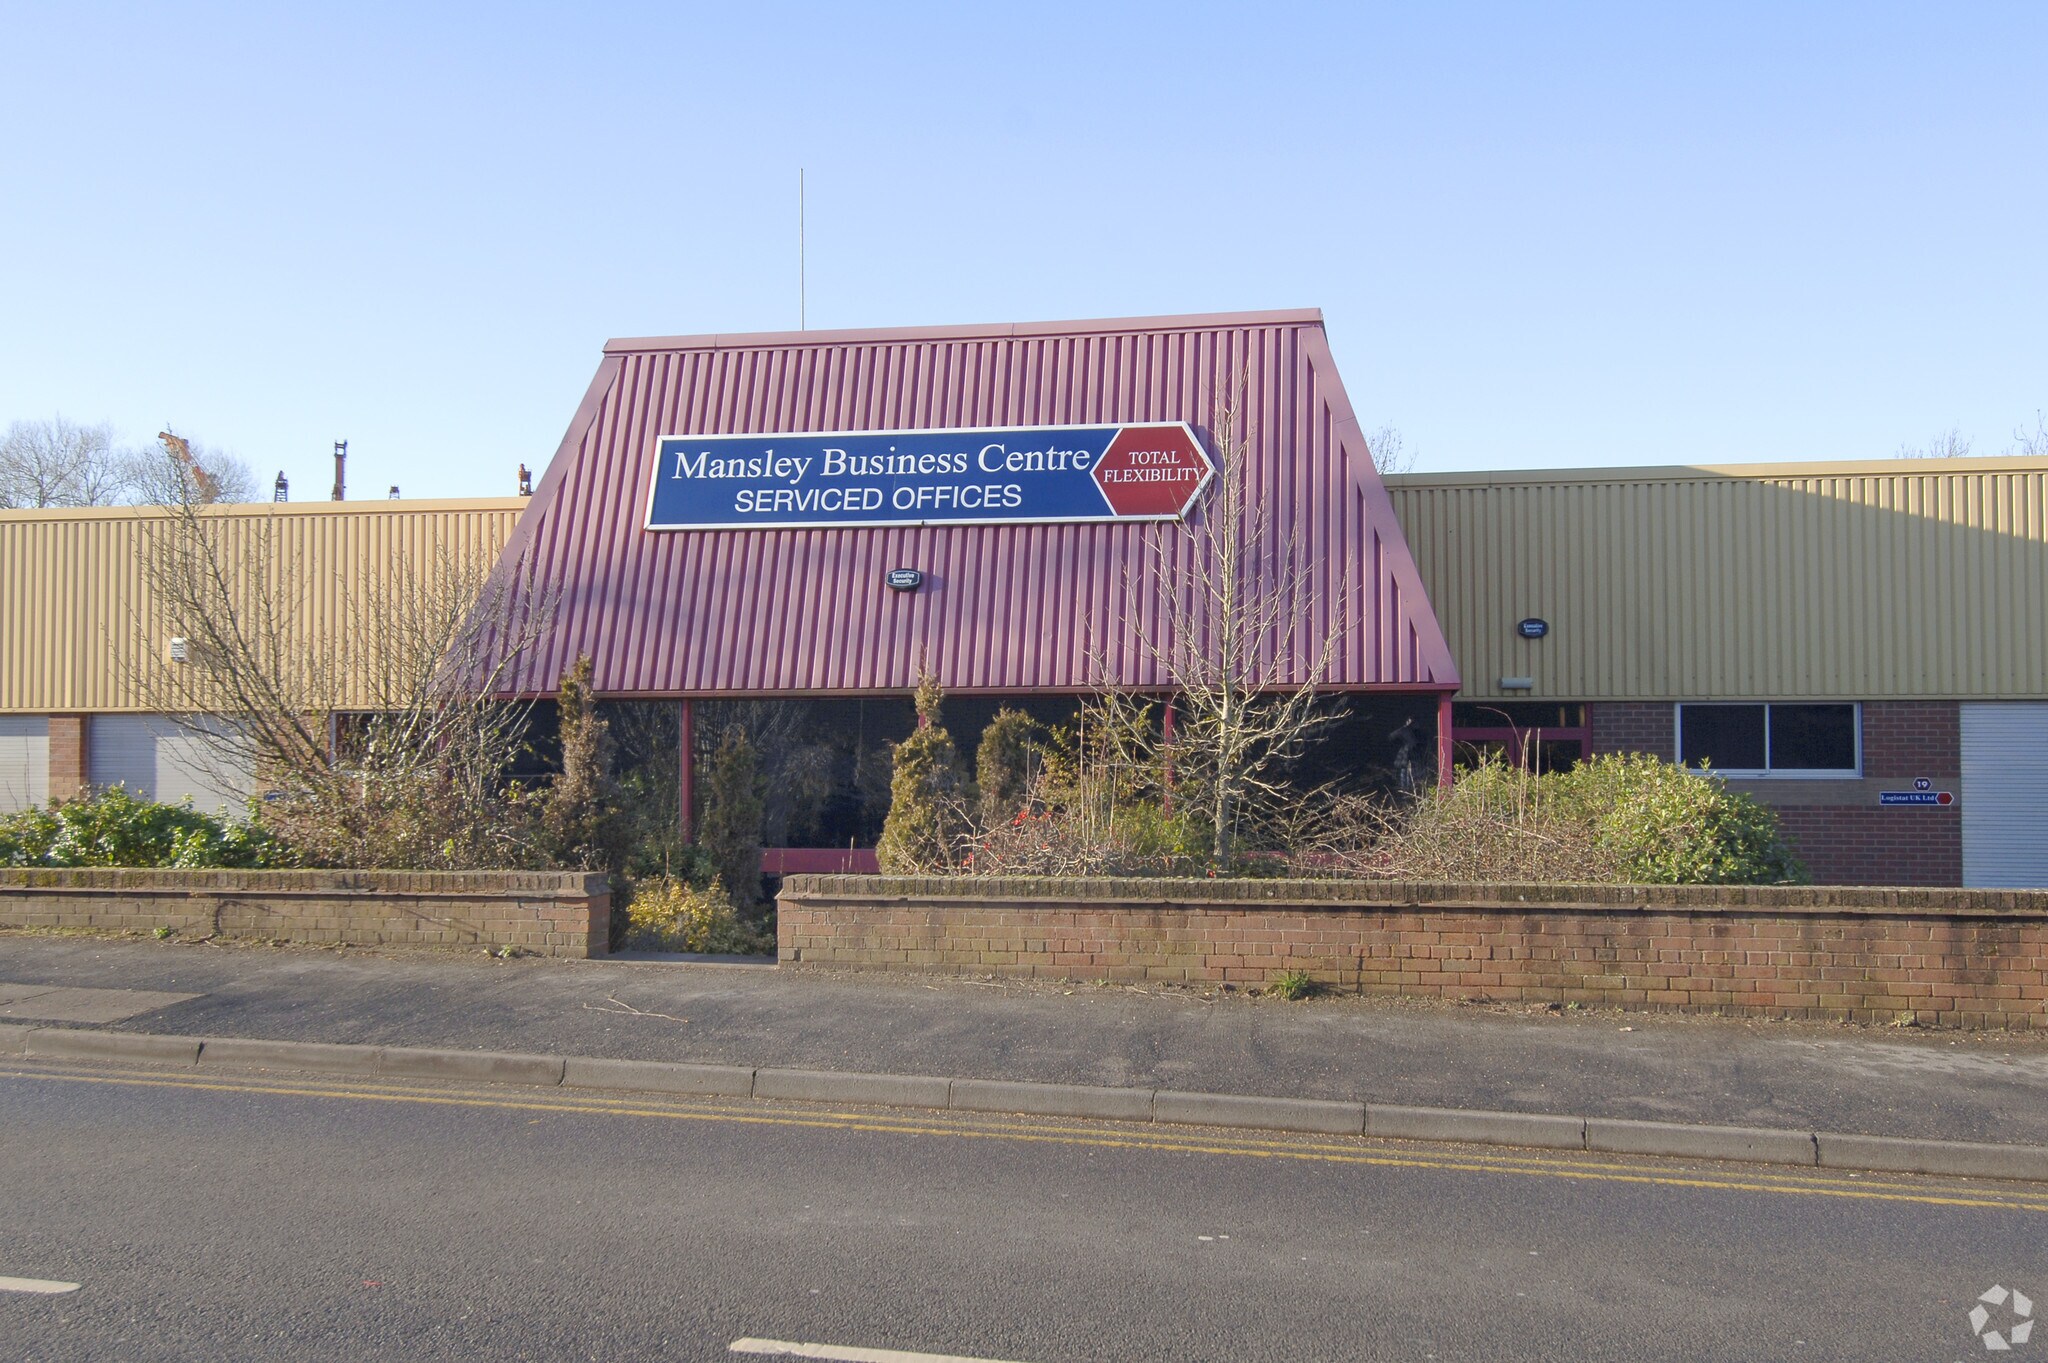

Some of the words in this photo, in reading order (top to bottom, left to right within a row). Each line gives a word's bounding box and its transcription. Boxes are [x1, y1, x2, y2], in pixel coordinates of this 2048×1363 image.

[671, 449, 812, 485] Mansley
[819, 446, 968, 476] Business
[977, 443, 1090, 473] Centre
[1128, 450, 1181, 465] TOTAL
[1103, 467, 1205, 483] FLEXIBILITY
[734, 488, 883, 513] SERVICED
[892, 484, 1022, 510] OFFICES
